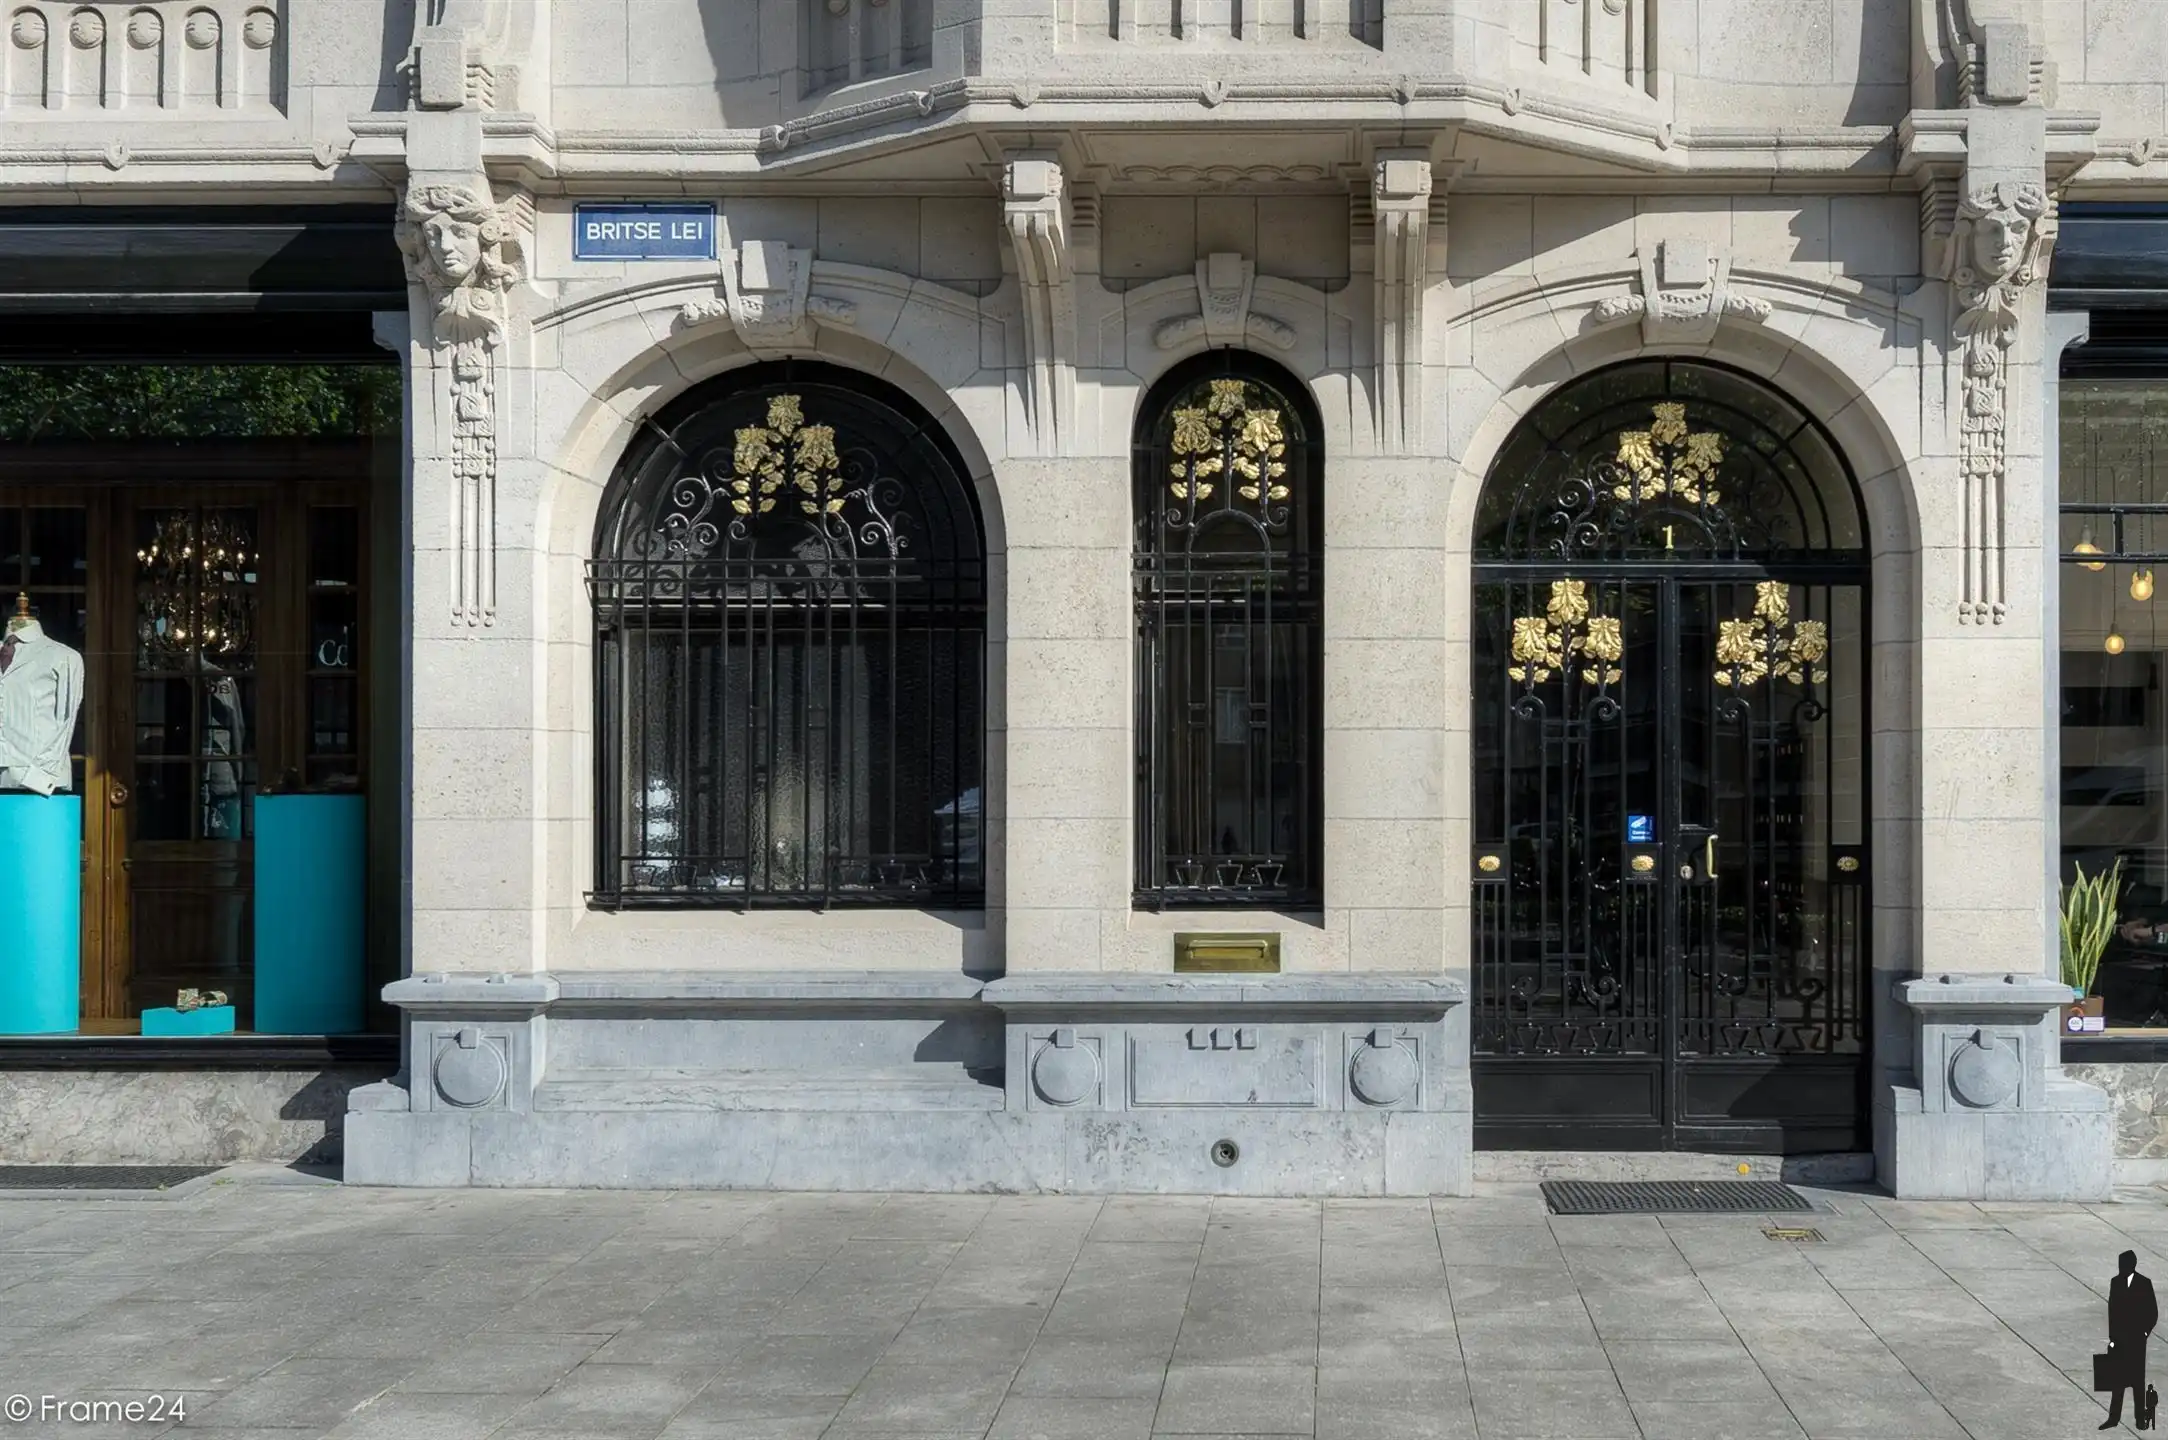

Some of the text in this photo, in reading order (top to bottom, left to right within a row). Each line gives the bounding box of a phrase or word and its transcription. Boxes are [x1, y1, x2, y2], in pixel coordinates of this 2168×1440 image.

[586, 222, 703, 240] BRITSE LEI
[1661, 524, 1675, 549] 1
